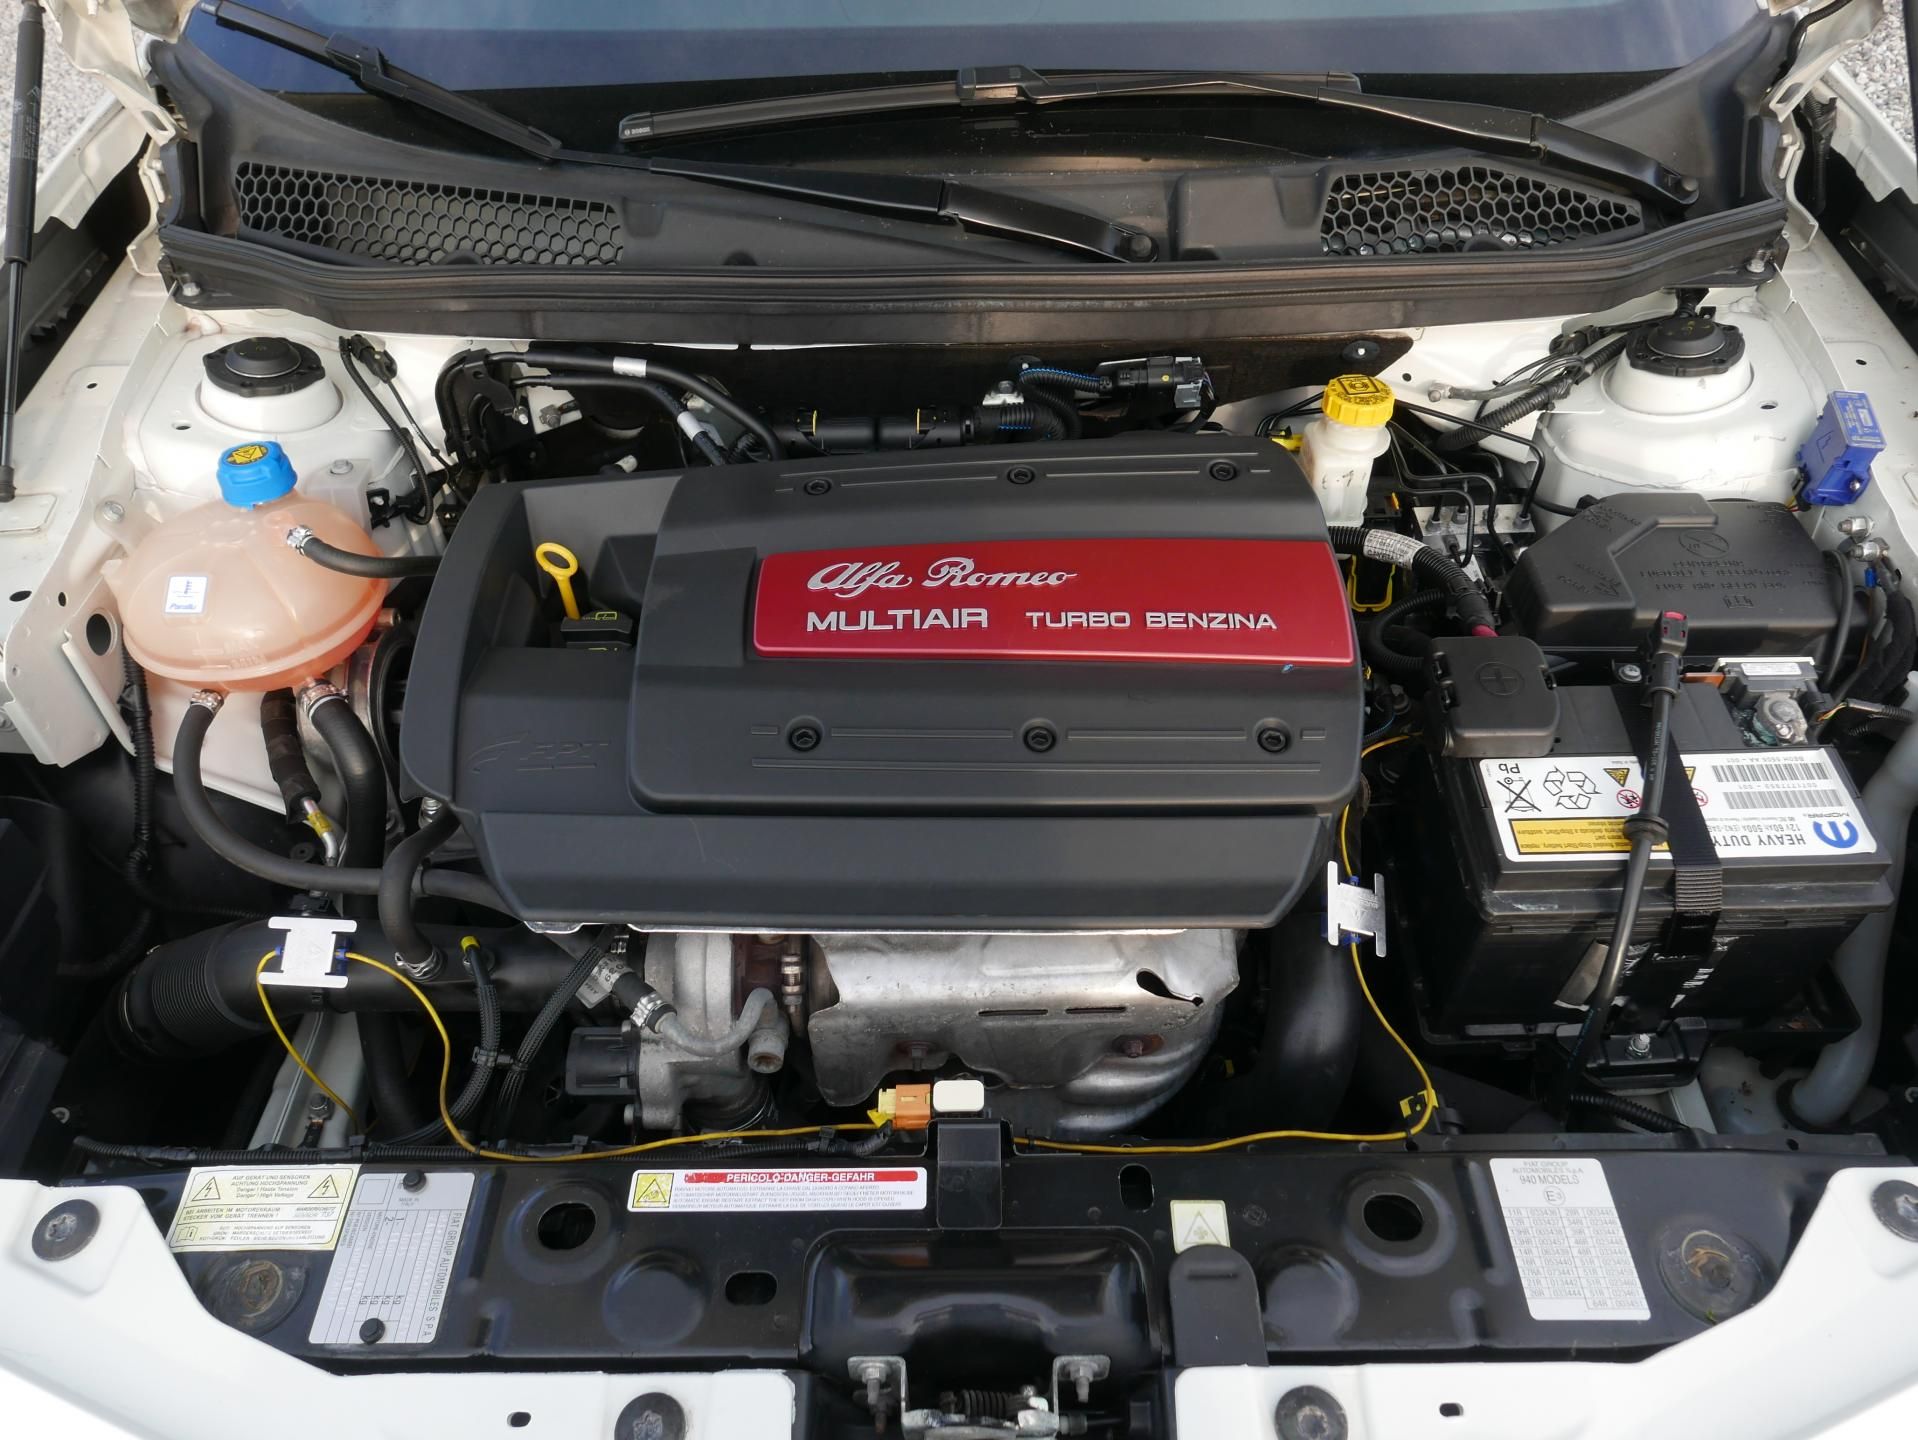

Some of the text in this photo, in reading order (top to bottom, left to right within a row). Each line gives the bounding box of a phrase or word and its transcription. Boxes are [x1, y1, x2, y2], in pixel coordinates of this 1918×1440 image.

[806, 557, 1077, 597] Alfa Romeo
[806, 608, 1278, 632] MULTIAIR TURBO BENZINA
[1498, 763, 1521, 774] Pb
[1711, 834, 1806, 847] HEAVY DUTY
[726, 1172, 875, 1183] PERICOLO-DANGER-GEFAHR
[1519, 1174, 1580, 1185] 940 MODELS
[451, 1212, 463, 1228] FIAT
[444, 1230, 458, 1256] GROUP
[429, 1257, 452, 1312] AUTOMOBILES
[360, 1295, 372, 1305] kg
[371, 1295, 383, 1305] kg
[382, 1295, 394, 1305] kg
[393, 1295, 404, 1305] kg
